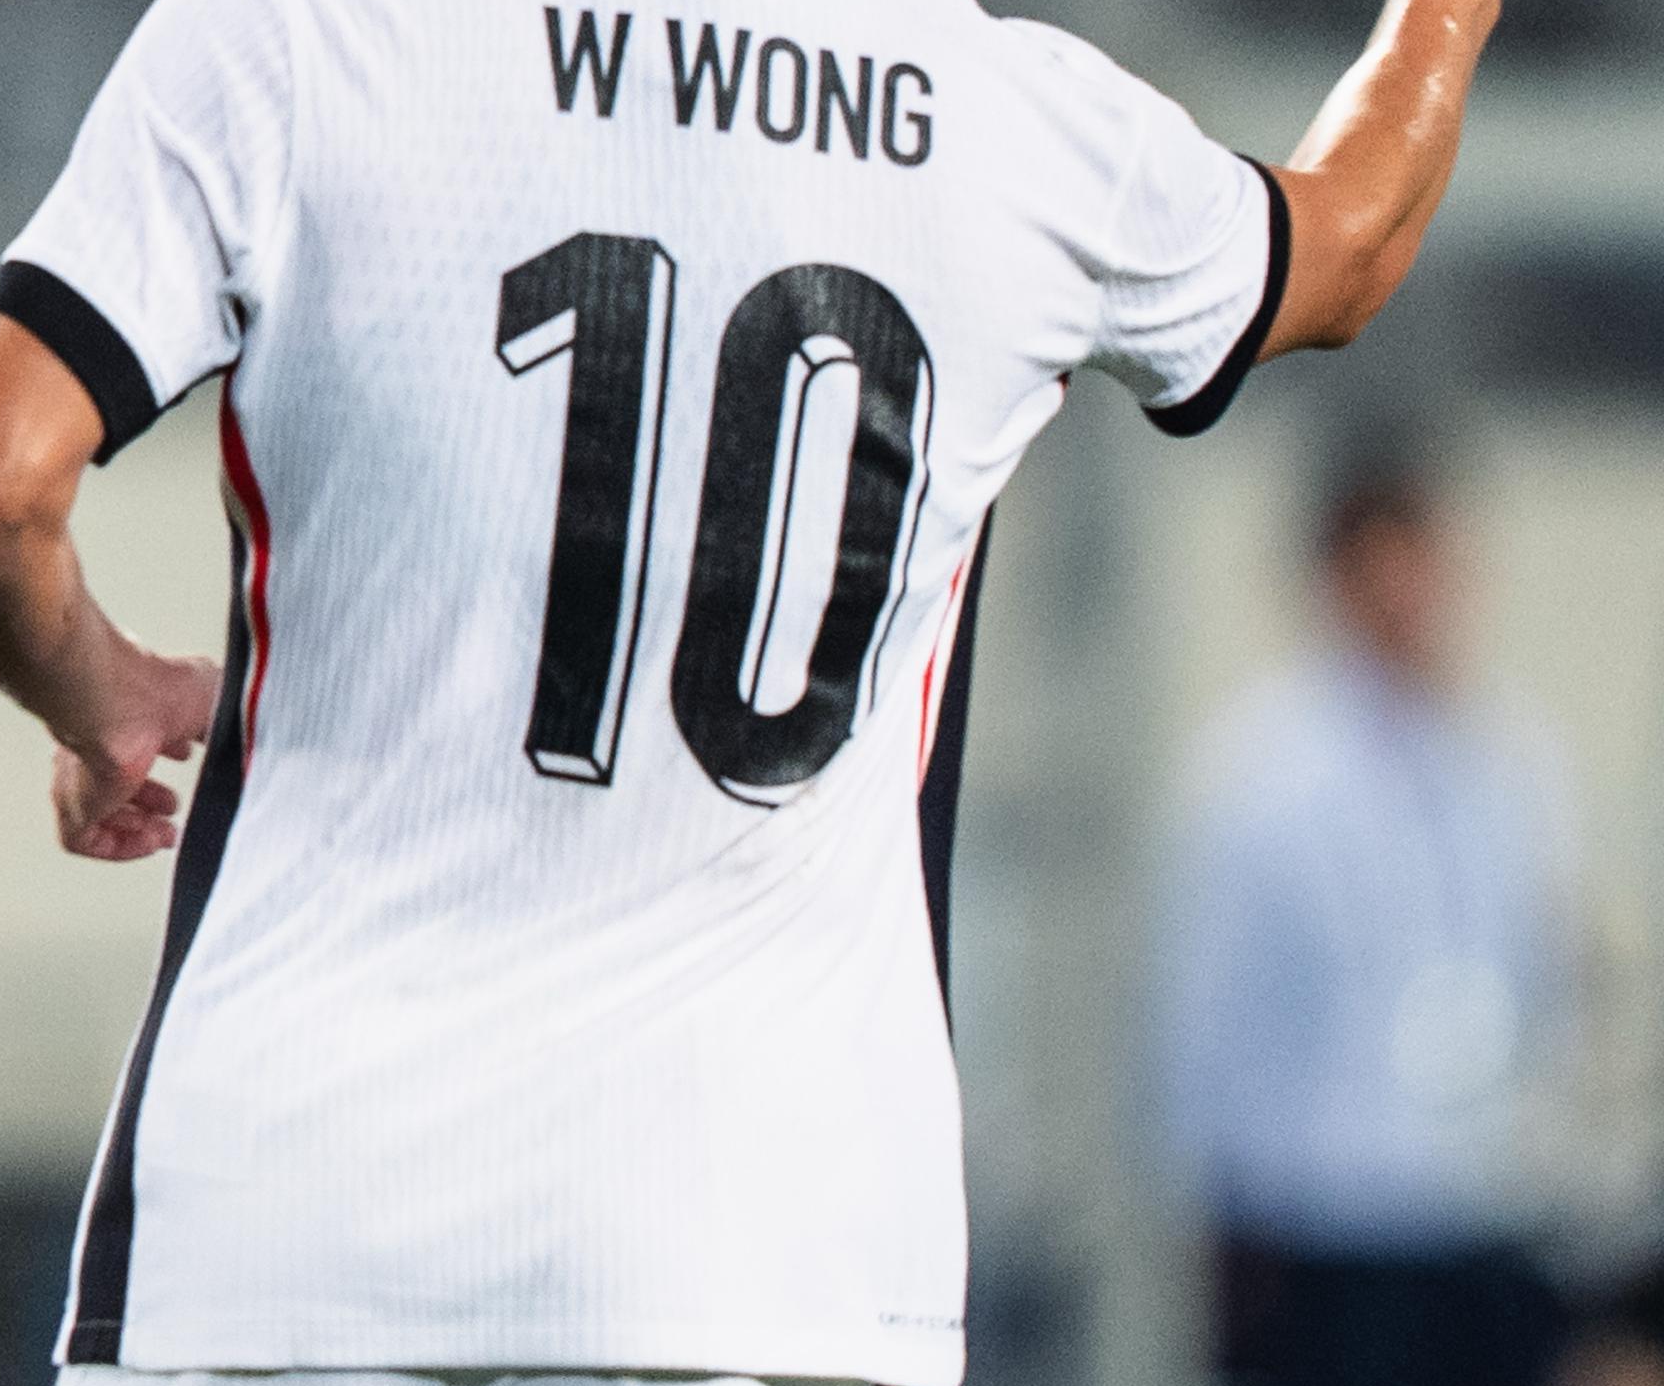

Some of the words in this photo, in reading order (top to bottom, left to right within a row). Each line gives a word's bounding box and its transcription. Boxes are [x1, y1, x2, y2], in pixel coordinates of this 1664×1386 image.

[543, 6, 632, 118] W
[666, 18, 934, 168] WONG
[496, 231, 935, 809] 10
